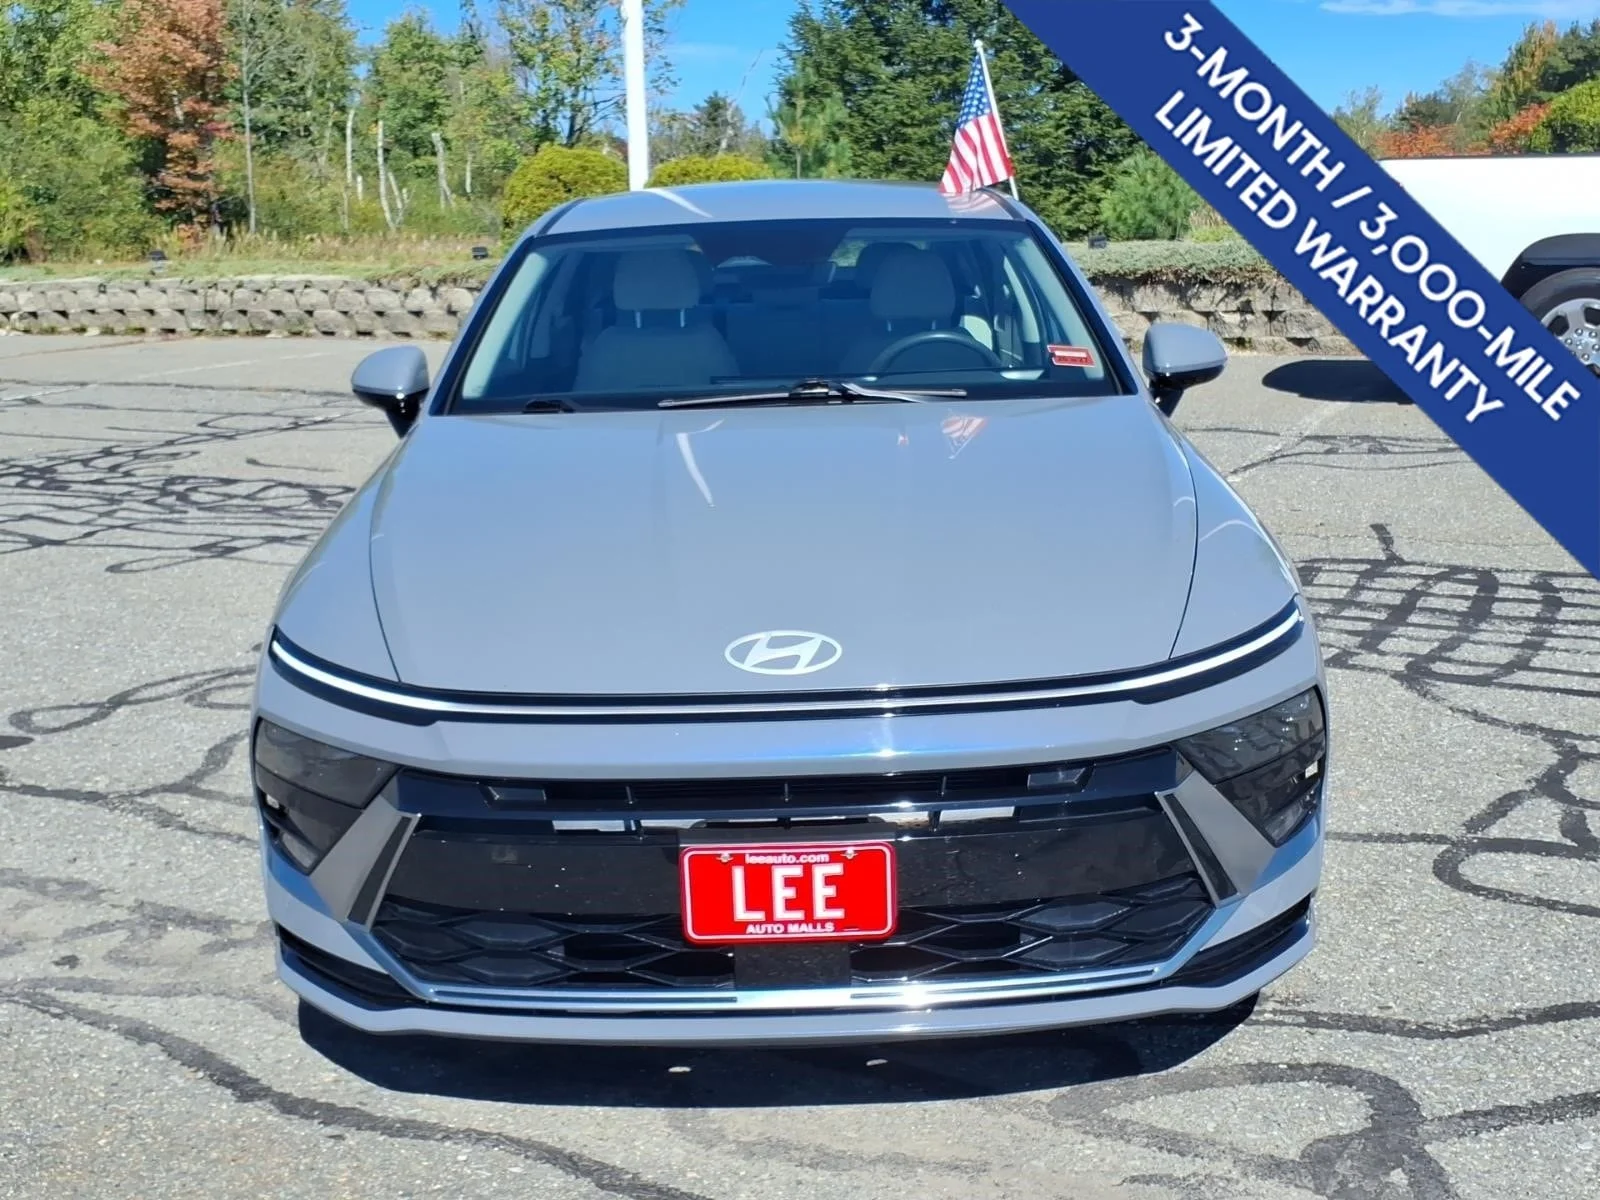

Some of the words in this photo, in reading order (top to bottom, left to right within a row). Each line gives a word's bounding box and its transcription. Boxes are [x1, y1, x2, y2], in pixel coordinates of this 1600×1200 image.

[745, 853, 830, 864] leeauto.com
[731, 863, 845, 922] LEE
[746, 923, 785, 934] AUTO
[787, 922, 835, 933] MALLS
